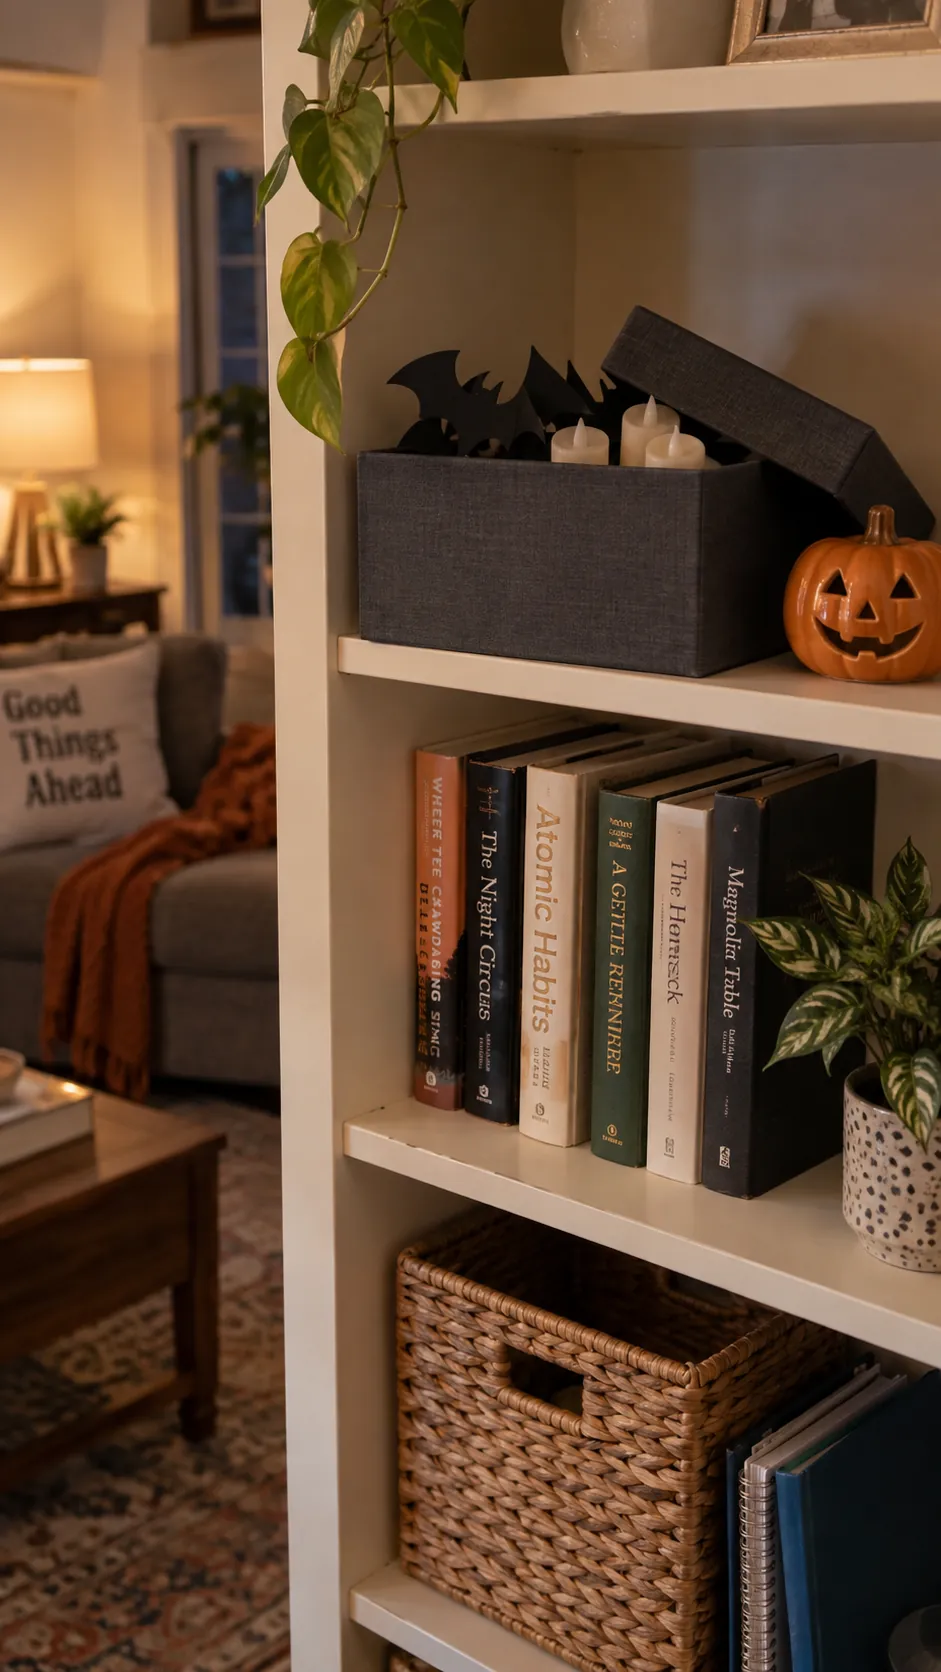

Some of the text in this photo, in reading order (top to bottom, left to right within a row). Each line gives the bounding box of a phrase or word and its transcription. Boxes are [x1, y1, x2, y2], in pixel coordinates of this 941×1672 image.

[3, 685, 82, 722] Good
[10, 725, 119, 764] Things
[26, 761, 123, 808] Ahead
[480, 830, 498, 869] The
[611, 859, 627, 877] A
[670, 859, 688, 898] The
[476, 875, 497, 940] Night
[532, 804, 561, 1034] Atomic Habits
[722, 865, 745, 961] Magnolia
